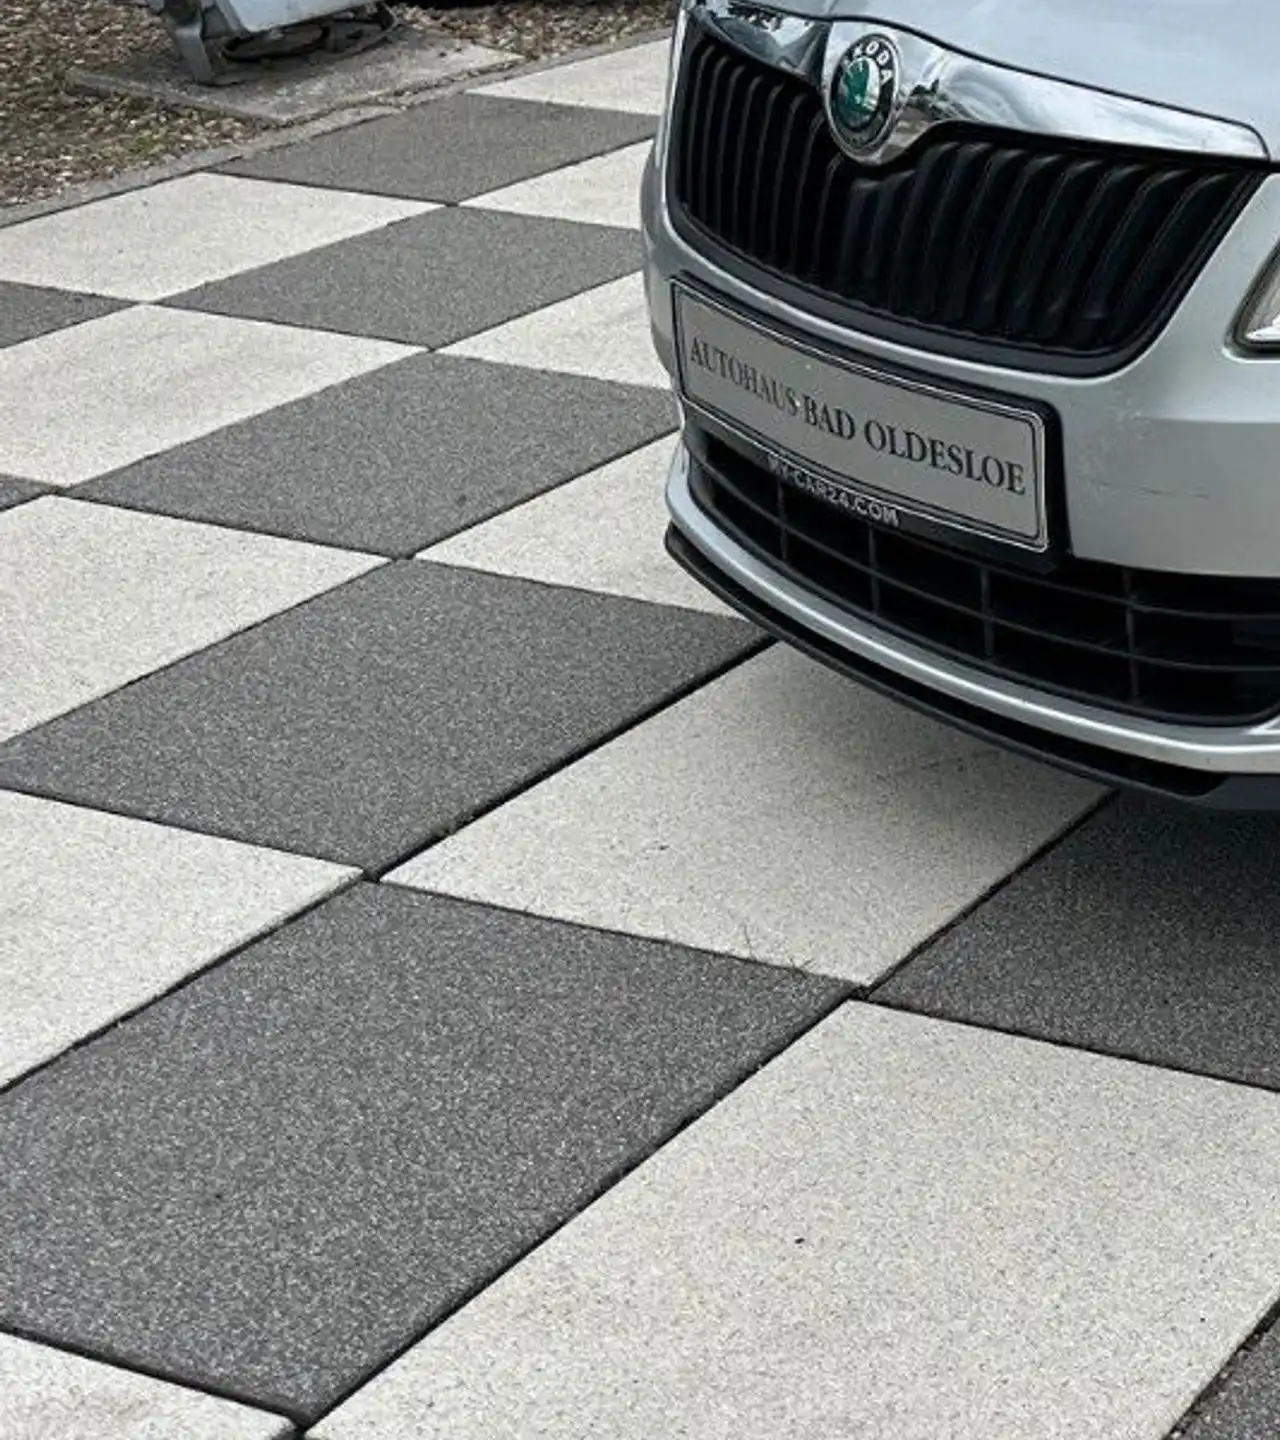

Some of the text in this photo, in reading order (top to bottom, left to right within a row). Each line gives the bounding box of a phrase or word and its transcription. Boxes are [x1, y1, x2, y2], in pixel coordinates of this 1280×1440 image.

[690, 337, 1027, 496] AUTOHAUS BAD OLDESLOE
